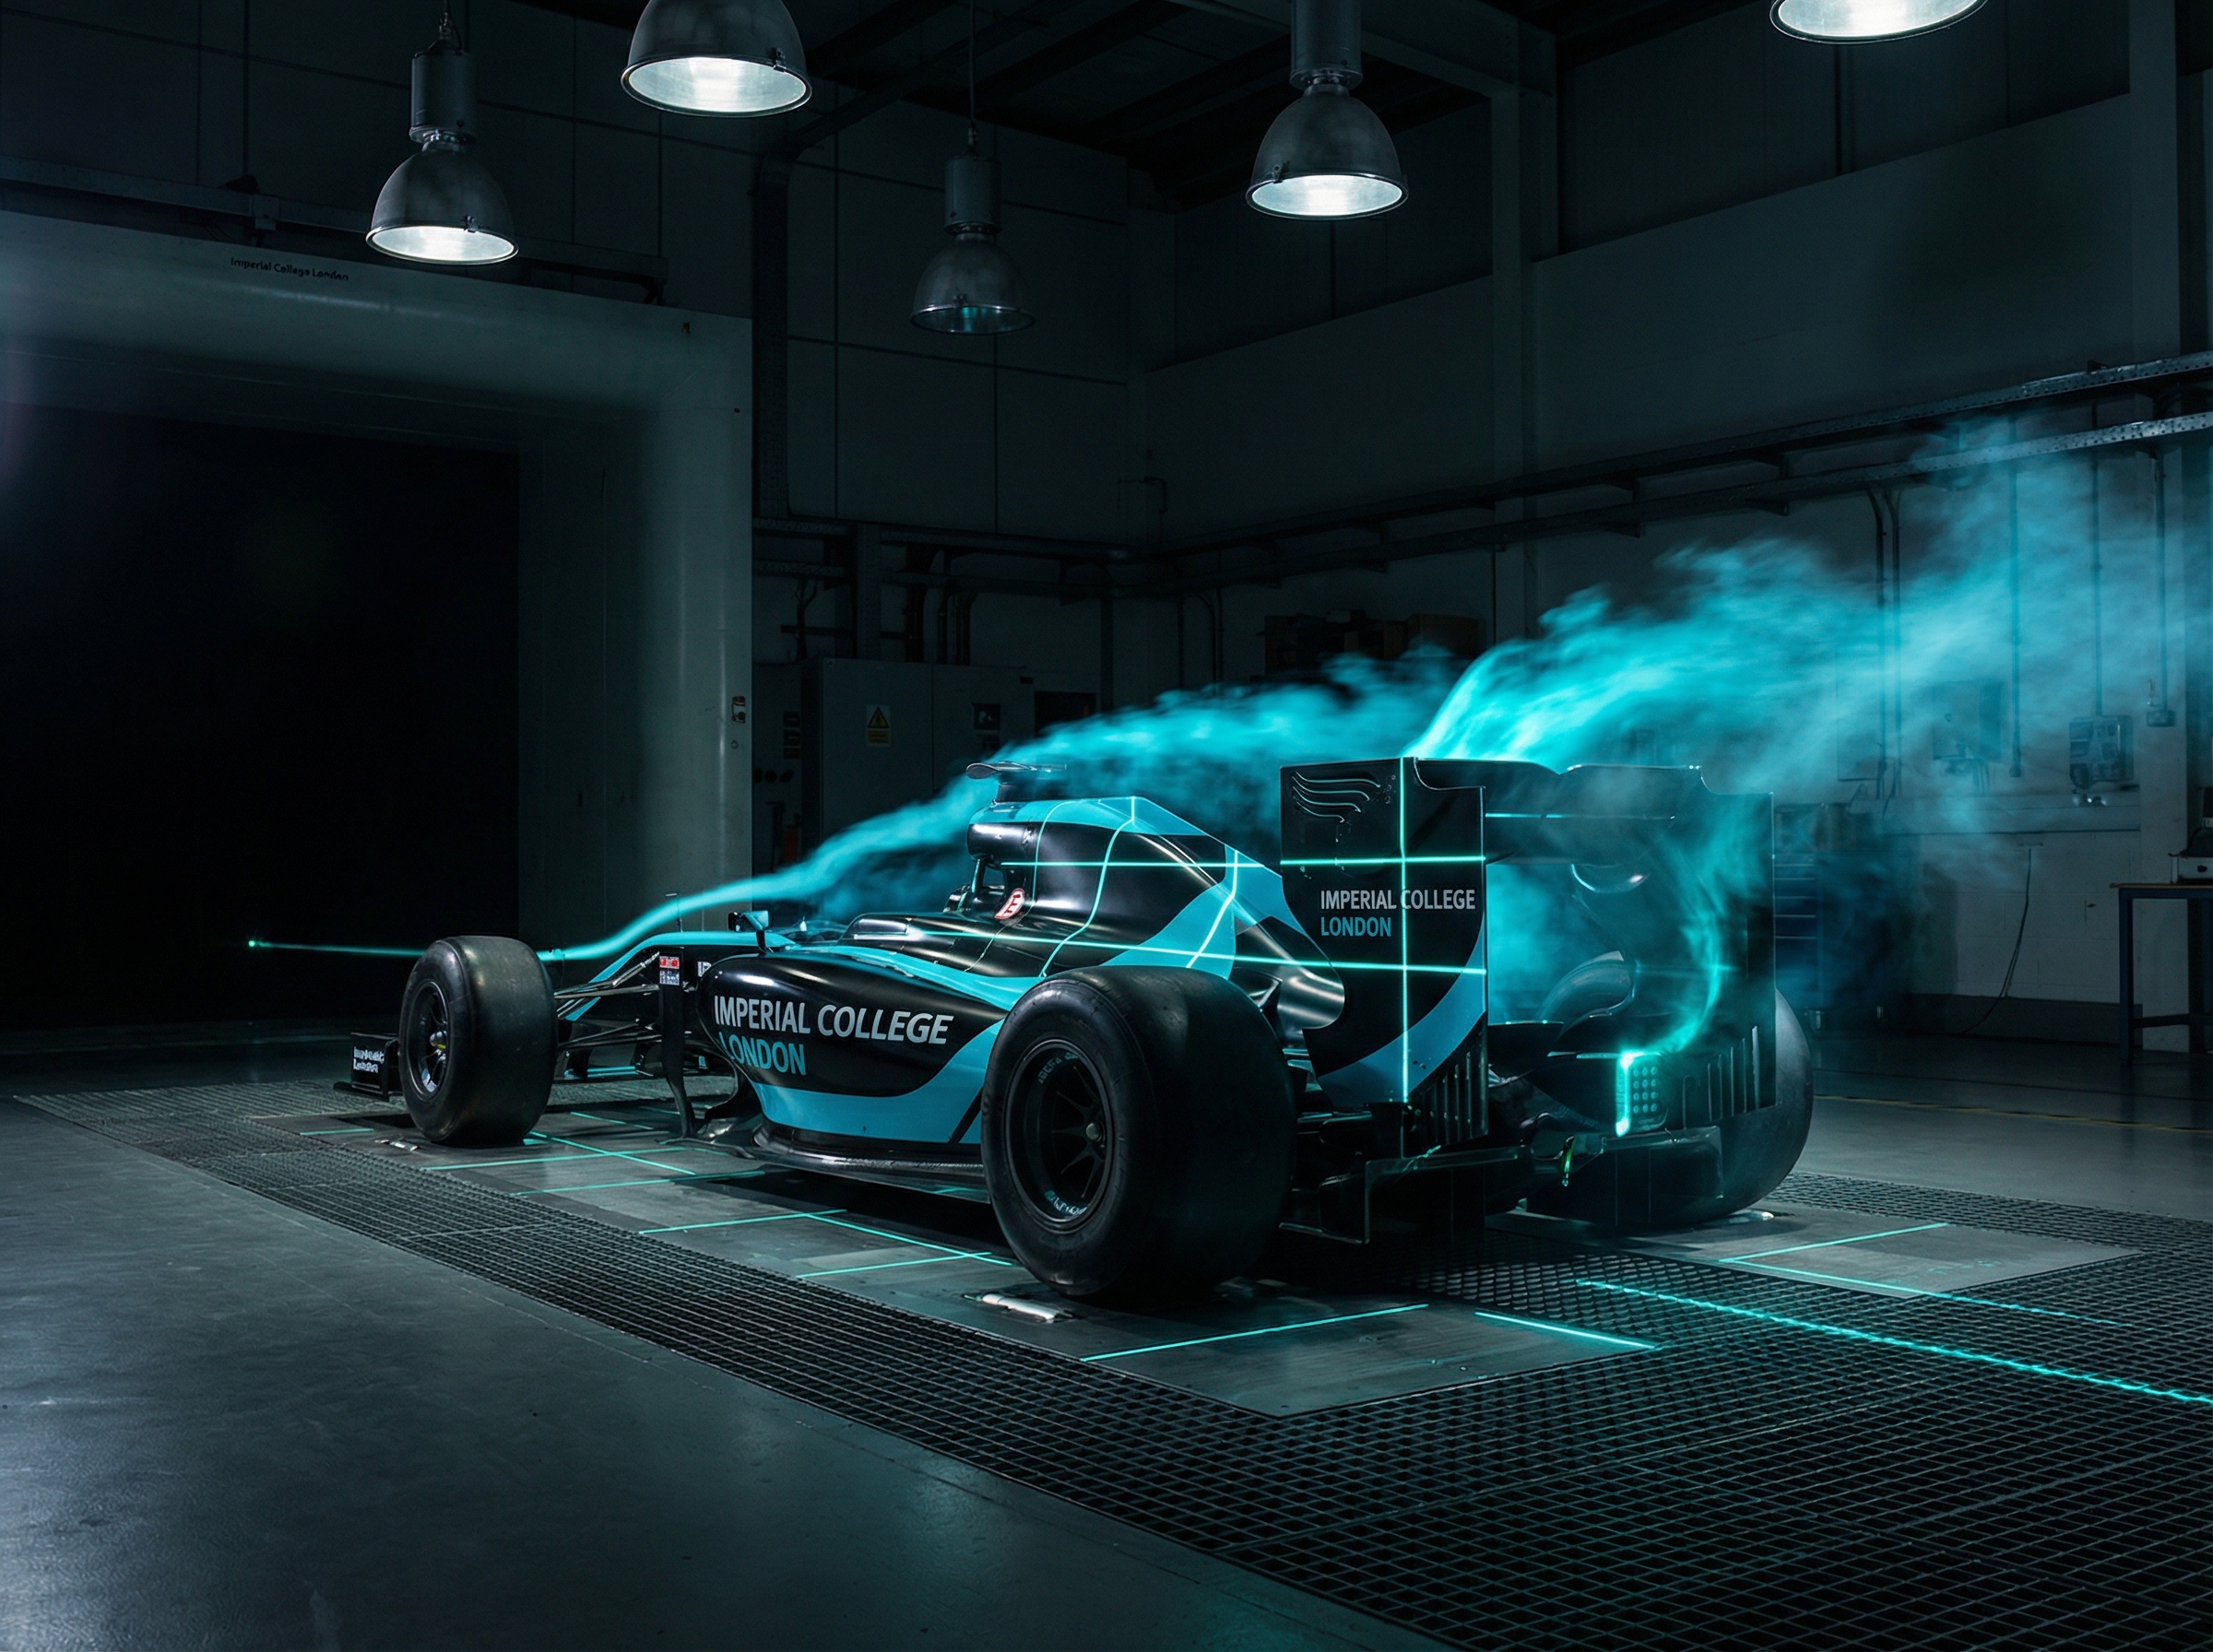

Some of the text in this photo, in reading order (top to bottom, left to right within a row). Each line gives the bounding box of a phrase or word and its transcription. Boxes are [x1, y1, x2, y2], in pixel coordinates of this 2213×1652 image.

[231, 256, 272, 270] Imperial
[1320, 889, 1476, 910] IMPERIAL COLLEGE
[1320, 916, 1391, 938] LONDON
[714, 995, 954, 1044] IMPERIAL COLLEGE
[718, 1031, 808, 1077] LONDON
